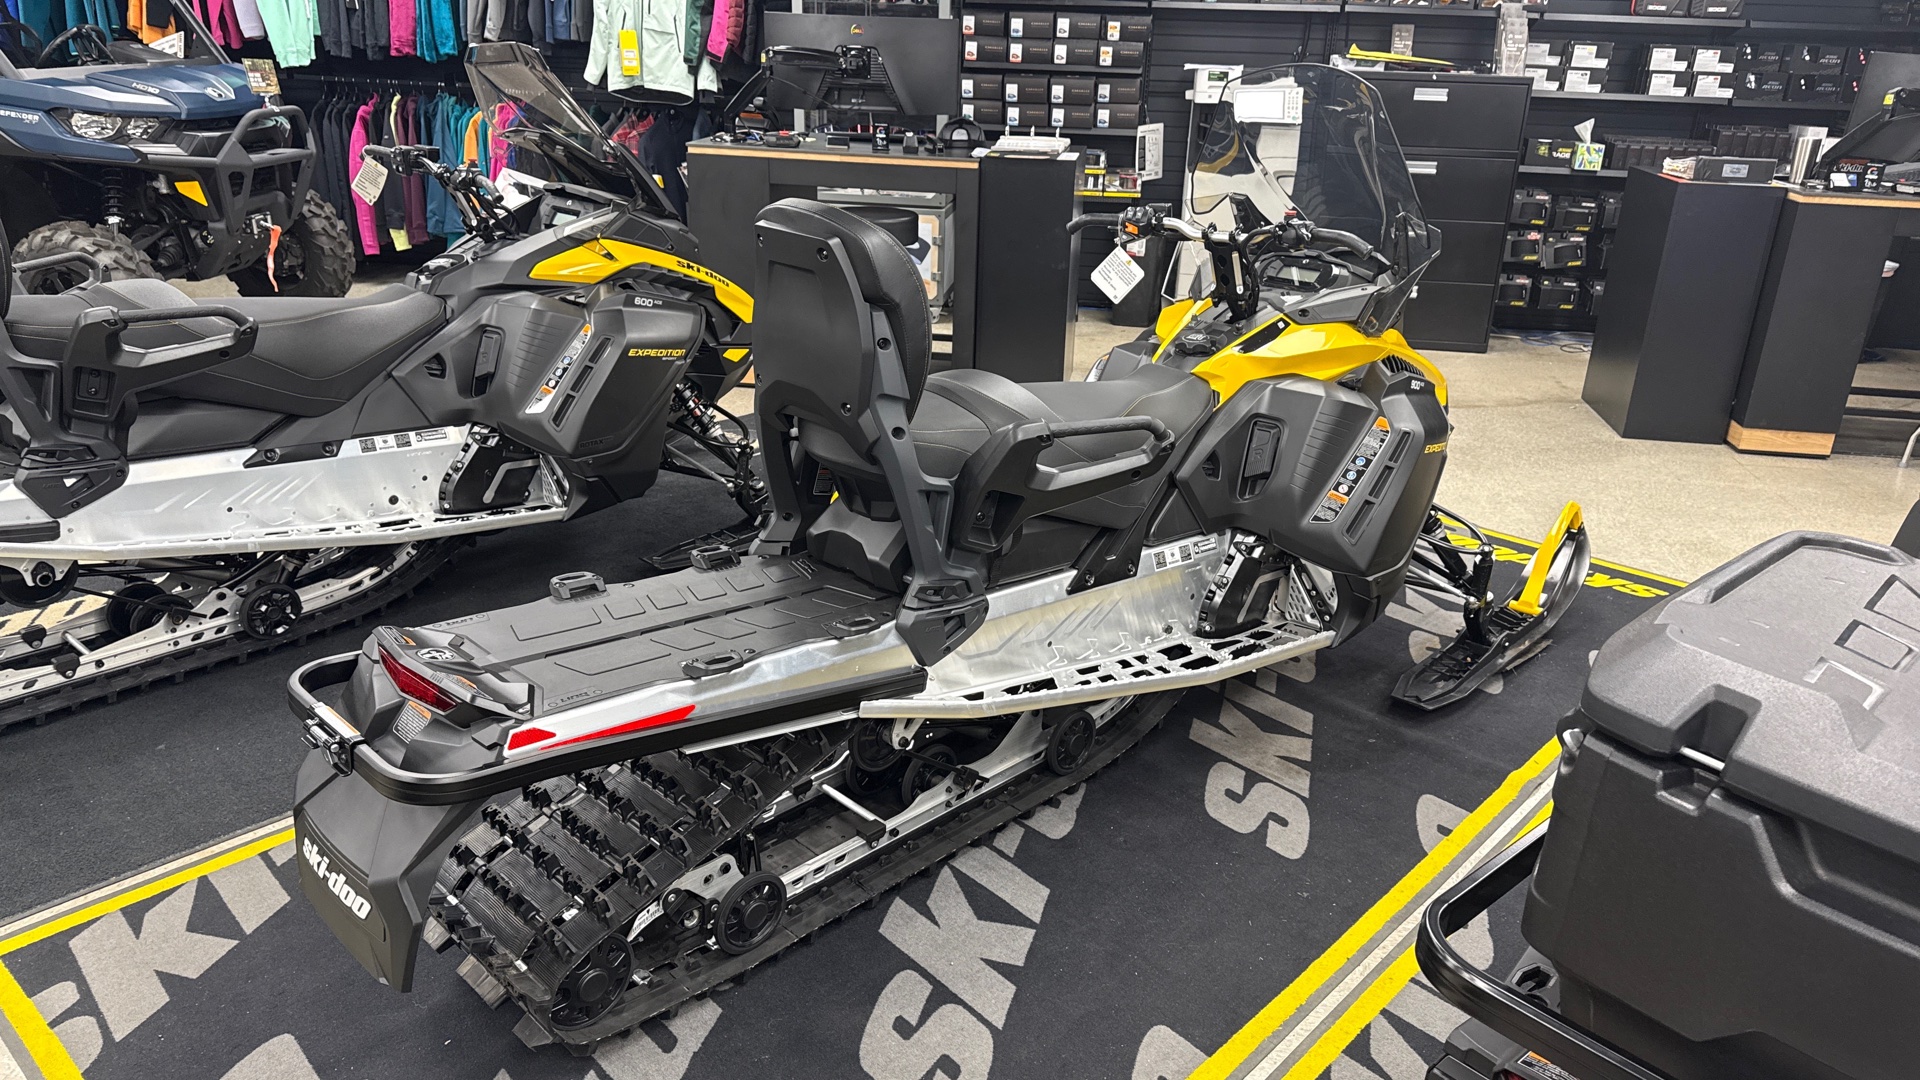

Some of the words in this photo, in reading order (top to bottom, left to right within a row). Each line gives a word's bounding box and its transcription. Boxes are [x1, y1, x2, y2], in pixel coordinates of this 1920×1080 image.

[634, 297, 654, 307] 600
[628, 348, 686, 357] EXPEDITION
[1410, 379, 1420, 390] 900
[302, 836, 372, 920] ski-doo
